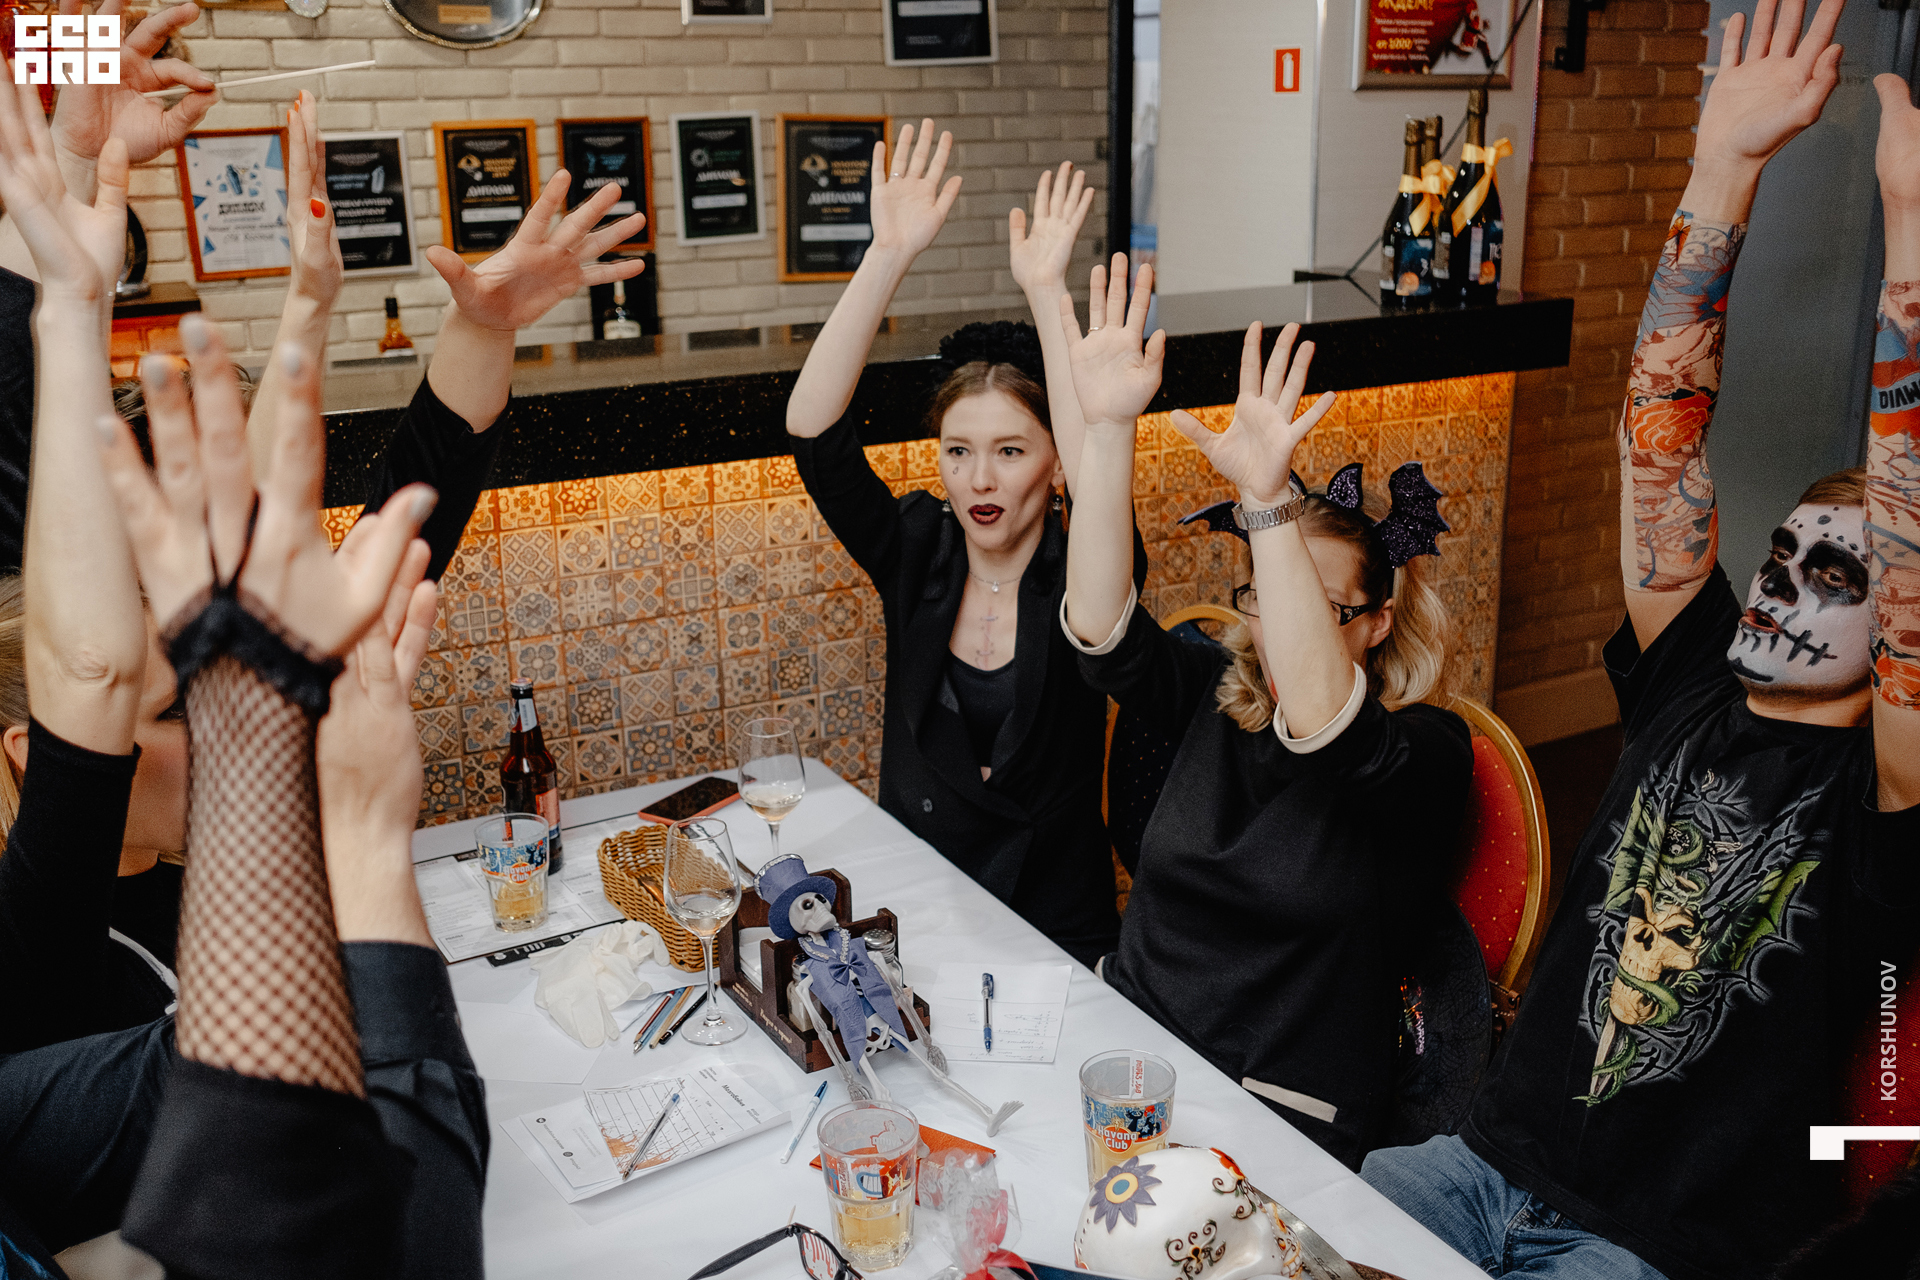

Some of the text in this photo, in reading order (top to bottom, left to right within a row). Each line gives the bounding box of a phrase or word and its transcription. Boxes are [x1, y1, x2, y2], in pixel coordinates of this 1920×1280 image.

[503, 864, 537, 875] Havana
[511, 873, 530, 882] Club
[1098, 1126, 1138, 1141] Havana
[1105, 1138, 1129, 1151] Club
